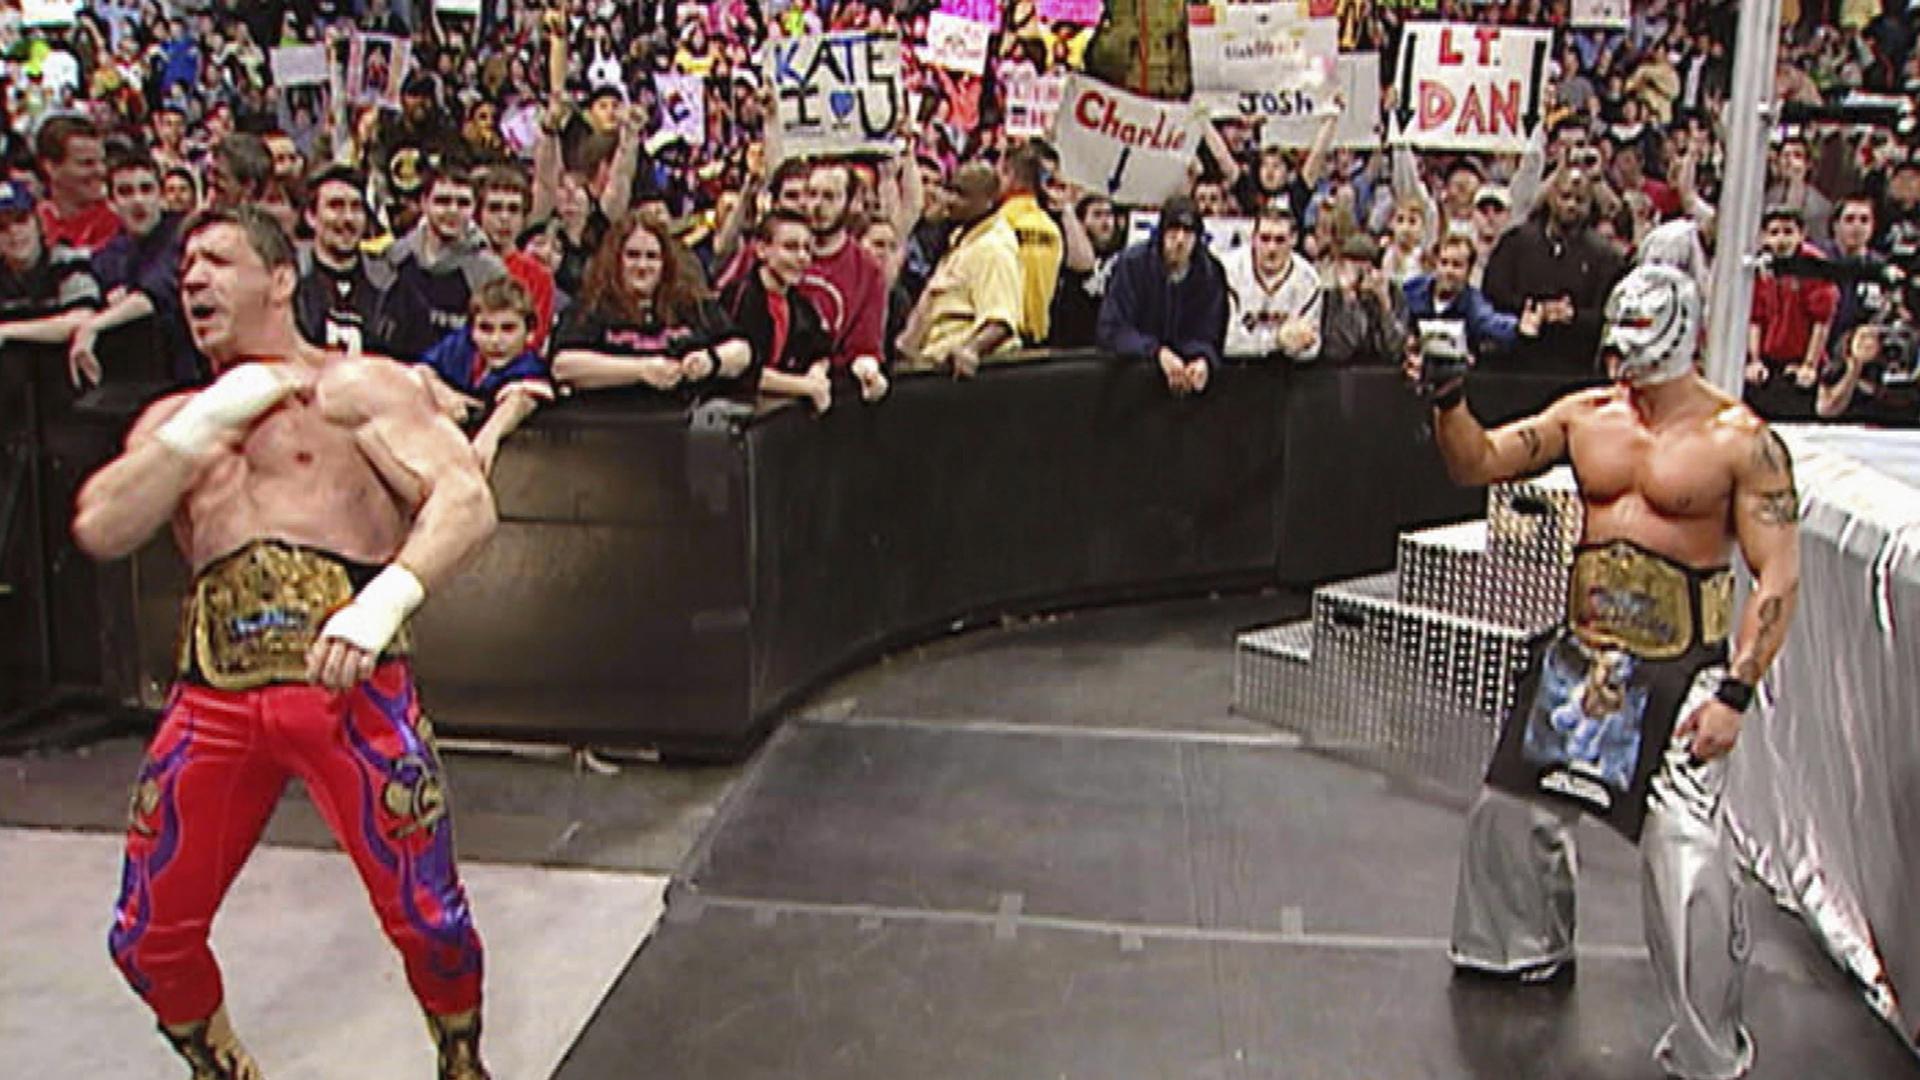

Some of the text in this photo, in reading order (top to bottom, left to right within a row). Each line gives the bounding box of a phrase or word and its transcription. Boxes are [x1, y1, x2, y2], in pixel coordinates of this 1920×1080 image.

[775, 32, 896, 84] KATE
[780, 80, 897, 138] I U
[1419, 79, 1521, 135] DAN
